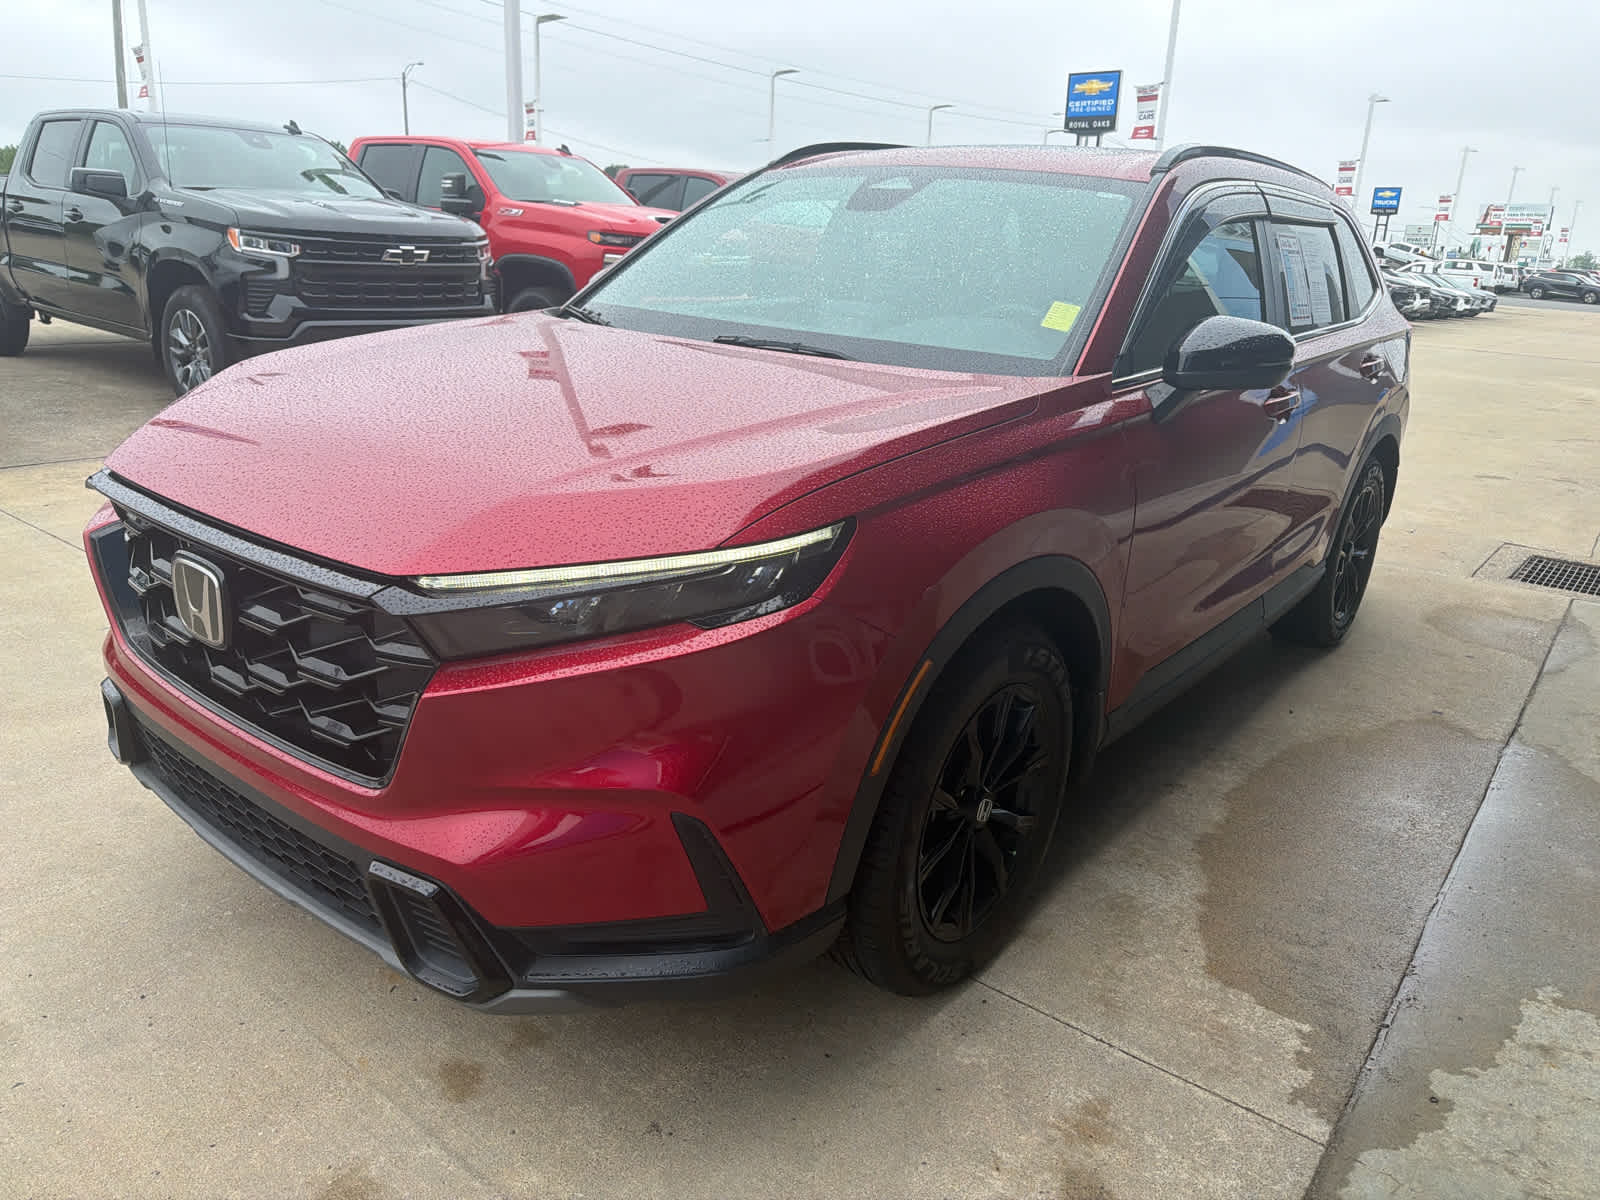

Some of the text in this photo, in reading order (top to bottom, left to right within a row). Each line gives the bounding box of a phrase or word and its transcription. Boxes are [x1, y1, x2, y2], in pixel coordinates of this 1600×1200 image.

[1068, 99, 1115, 107] CERTIFIED
[1069, 120, 1110, 129] ROYAL OAKS
